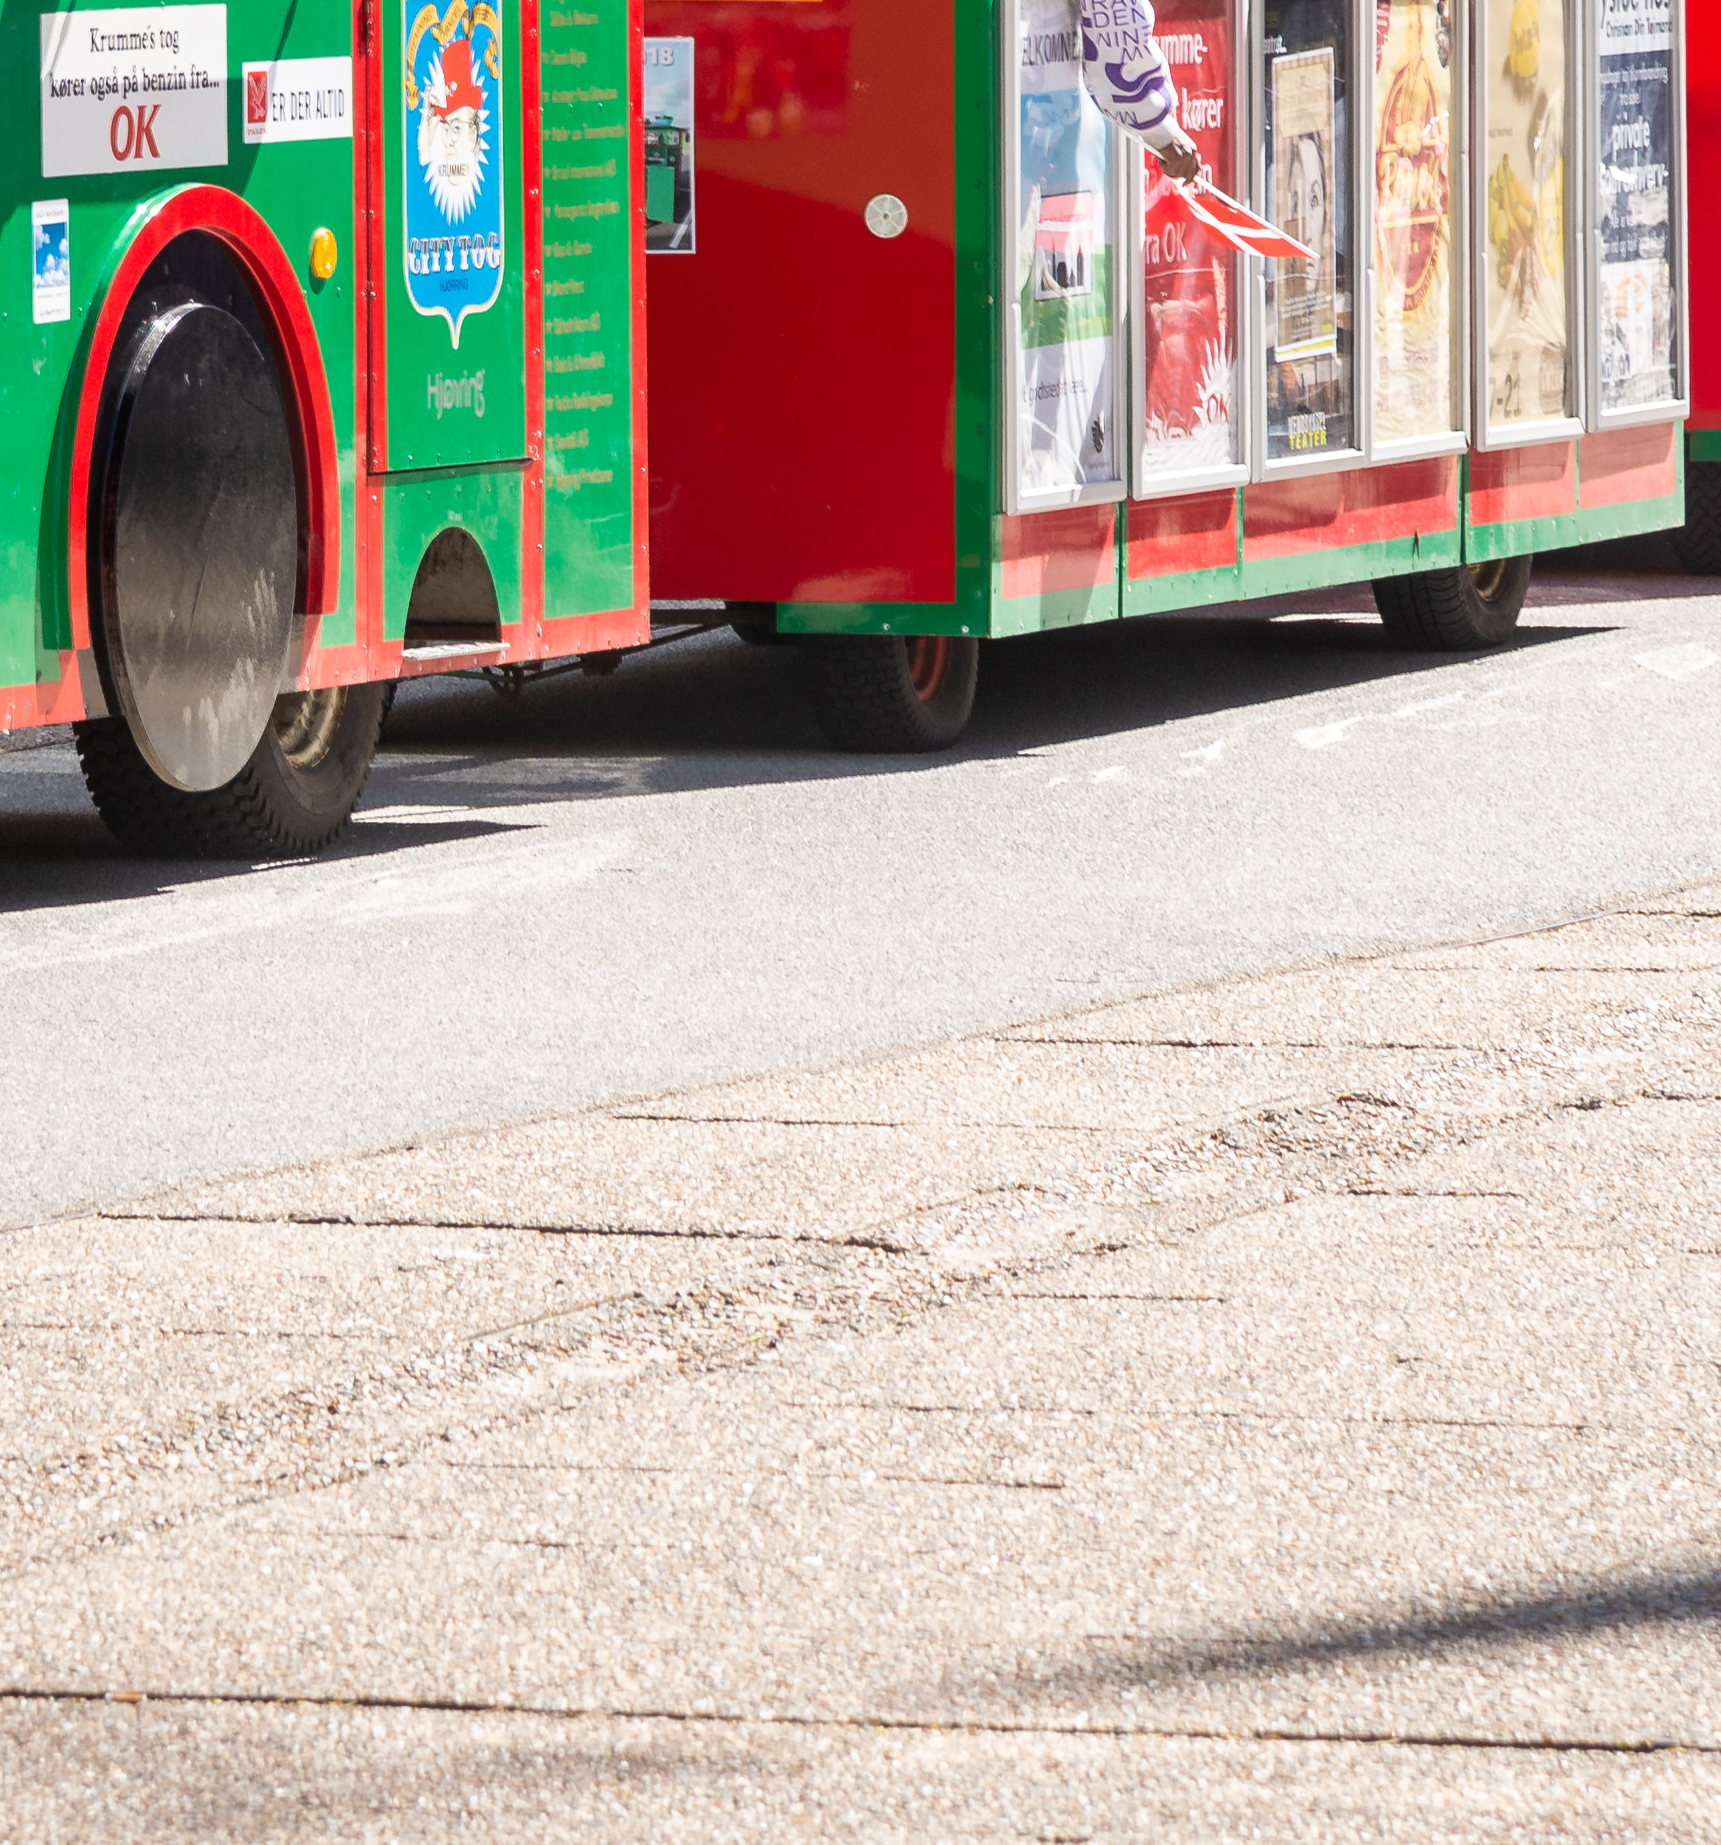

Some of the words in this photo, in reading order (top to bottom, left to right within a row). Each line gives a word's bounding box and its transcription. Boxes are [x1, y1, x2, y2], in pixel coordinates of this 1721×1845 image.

[159, 28, 180, 54] tog
[49, 72, 85, 100] kører
[90, 66, 119, 101] også
[123, 66, 139, 100] på
[142, 63, 187, 92] benzin
[189, 63, 220, 91] fra...
[272, 93, 286, 122] ER
[290, 91, 312, 121] DER
[315, 88, 345, 119] ALTID
[1182, 87, 1224, 131] kører
[110, 104, 161, 162] OK
[1612, 112, 1650, 162] private
[1164, 221, 1187, 263] OK
[427, 369, 485, 418] Hjørring
[1207, 395, 1229, 424] OK
[1289, 430, 1326, 450] TEATER
